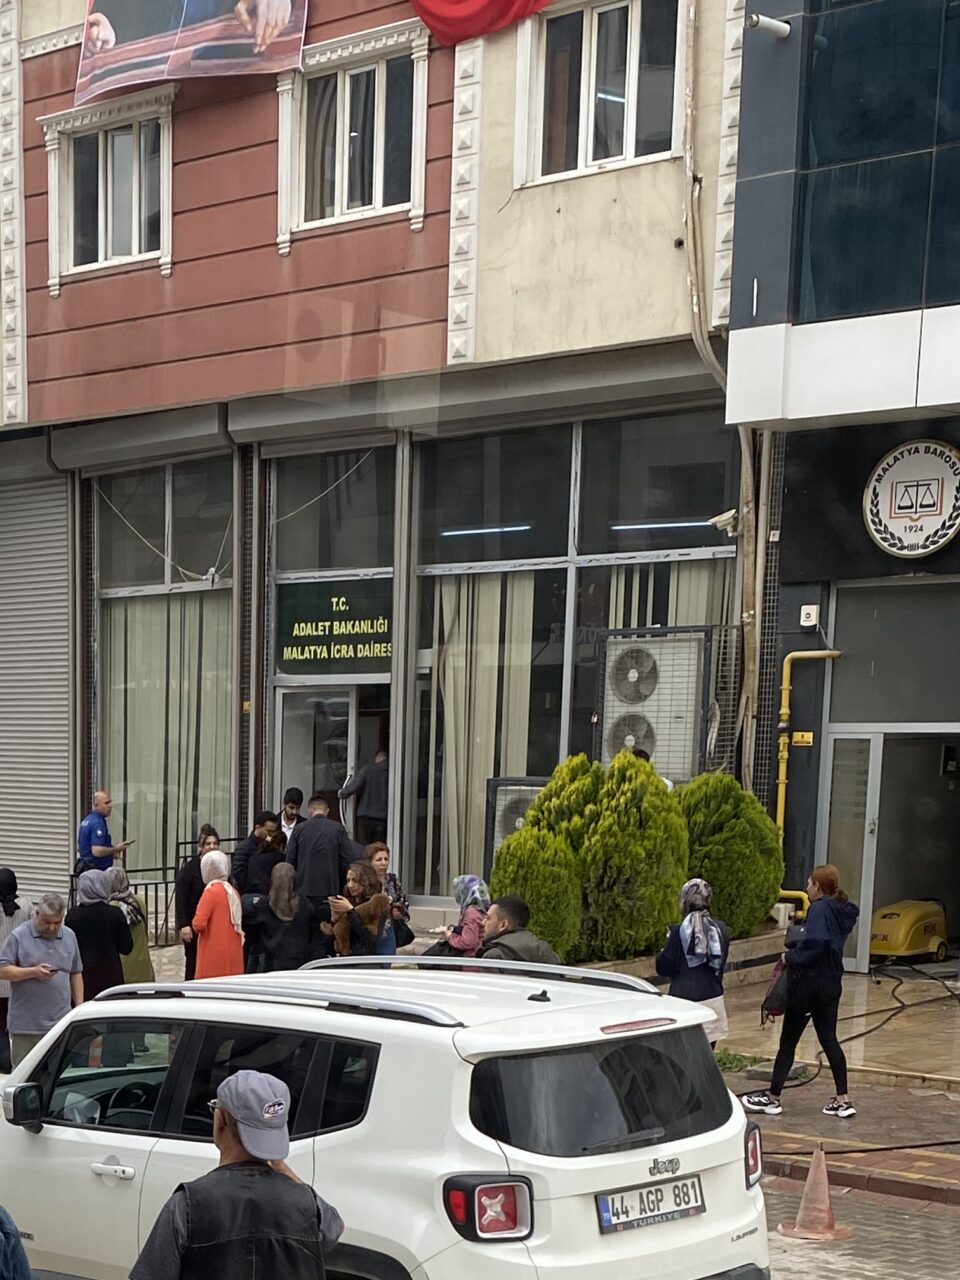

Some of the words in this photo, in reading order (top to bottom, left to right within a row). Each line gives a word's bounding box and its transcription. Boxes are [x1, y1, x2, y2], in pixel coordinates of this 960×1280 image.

[875, 446, 920, 484] MALATYA
[924, 445, 960, 477] BAROSU
[904, 525, 924, 533] 1924
[331, 597, 349, 611] T.C.
[292, 621, 331, 637] ADALET
[333, 616, 388, 635] BAKANLIĞI
[283, 645, 328, 660] MALATYA
[330, 642, 355, 659] İCRA
[649, 1158, 680, 1176] Jeep
[611, 1195, 630, 1220] 44
[639, 1187, 664, 1216] AGP
[673, 1180, 699, 1207] 881
